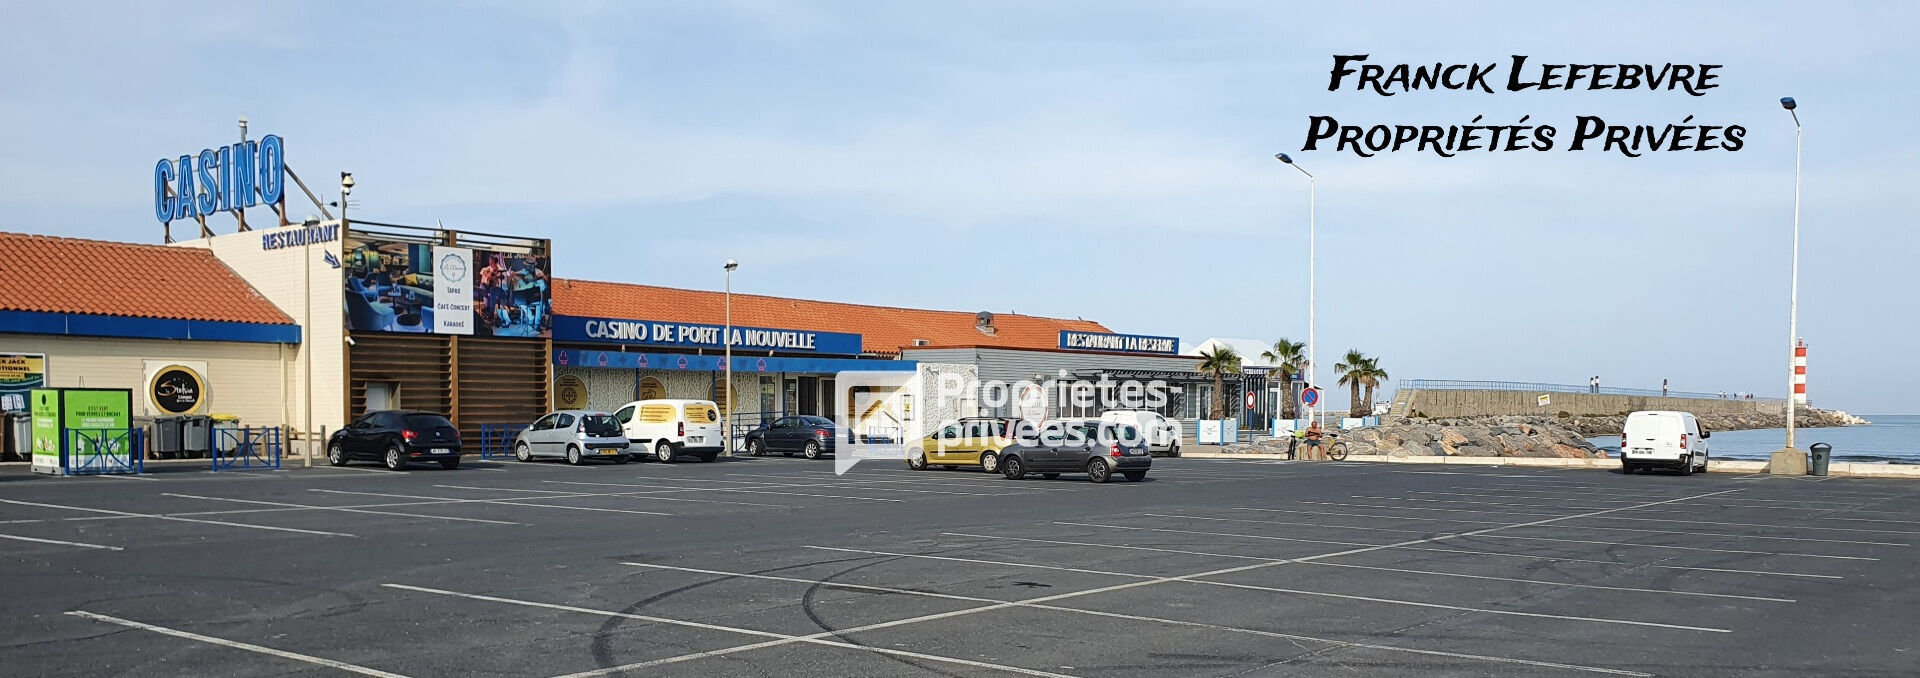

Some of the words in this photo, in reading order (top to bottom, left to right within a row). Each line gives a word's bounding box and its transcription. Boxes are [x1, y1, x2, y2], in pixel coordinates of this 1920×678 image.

[155, 134, 284, 223] CASINO
[262, 224, 340, 251] RESTAURANT
[585, 320, 648, 340] CASINO
[653, 324, 675, 342] DE
[678, 325, 719, 344] PORT
[724, 328, 743, 346] LA
[745, 330, 816, 349] NOUVELLE
[1067, 333, 1125, 349] RESTAURANT
[1125, 336, 1138, 350] LA
